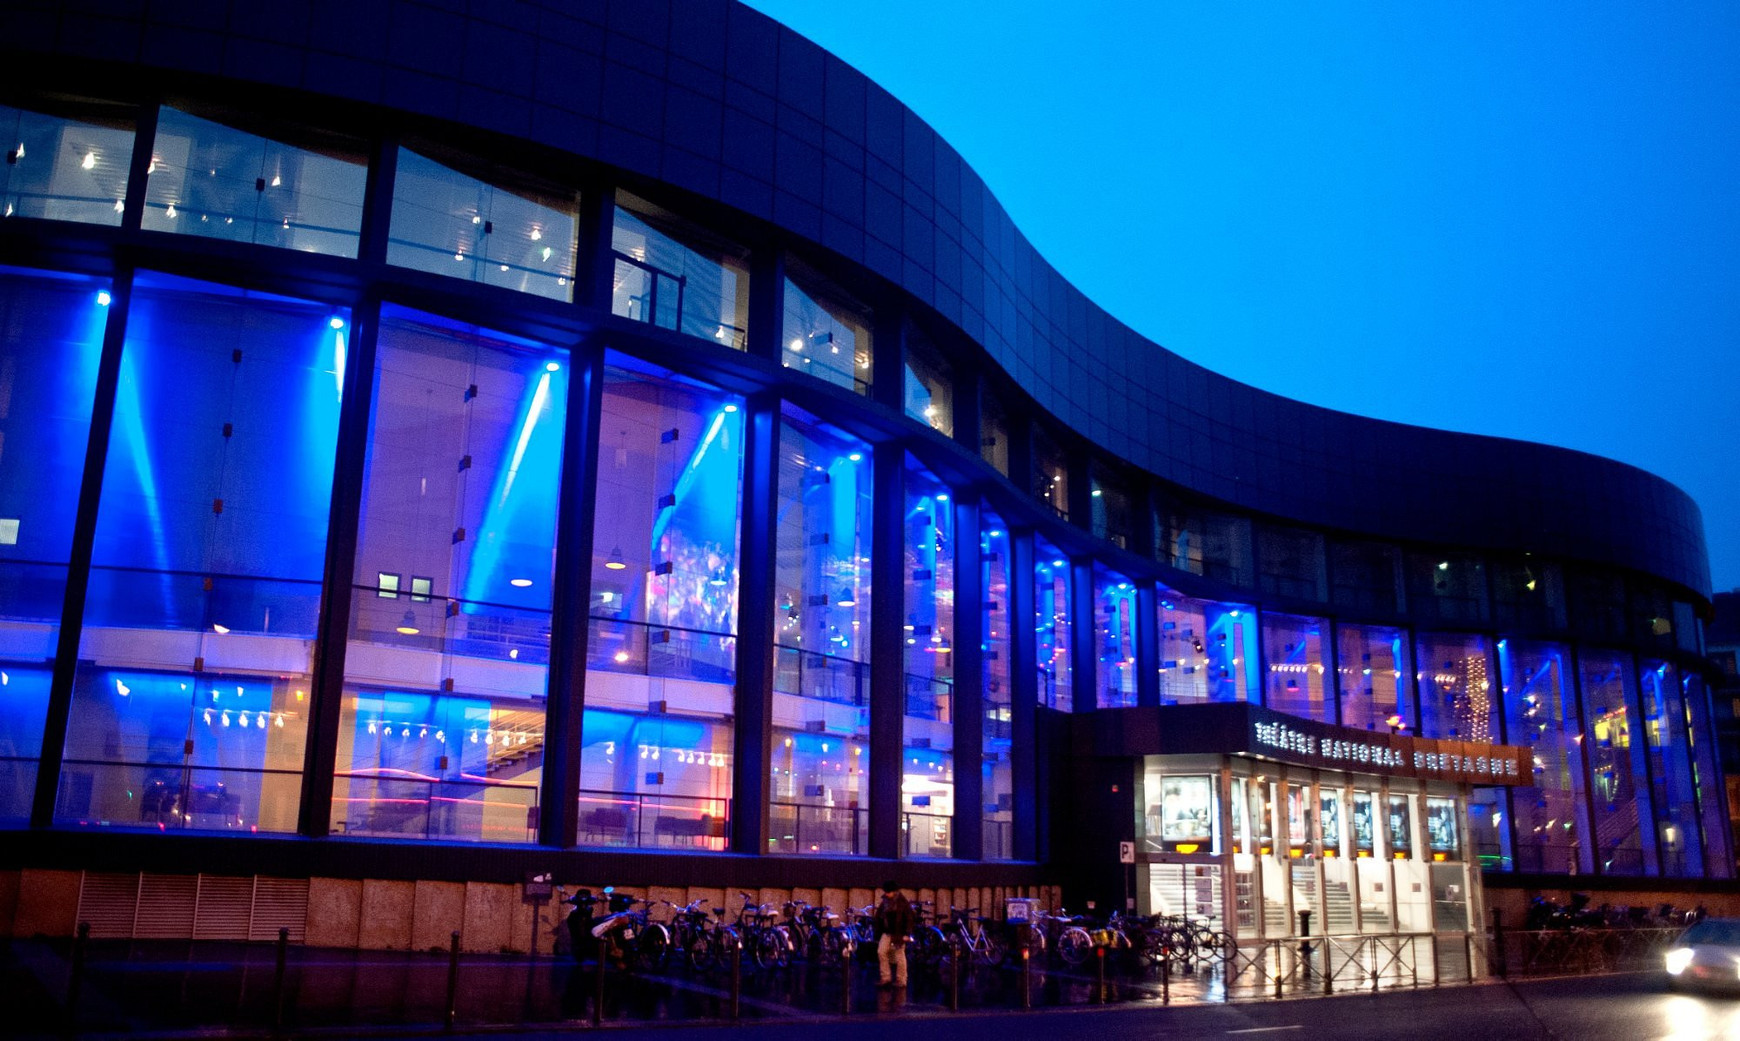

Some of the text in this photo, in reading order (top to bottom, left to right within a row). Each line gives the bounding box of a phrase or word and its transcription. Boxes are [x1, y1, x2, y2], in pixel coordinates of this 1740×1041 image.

[1321, 738, 1405, 766] NATIONAL
[1413, 751, 1518, 775] BRETAGNE
[1122, 843, 1129, 859] P
